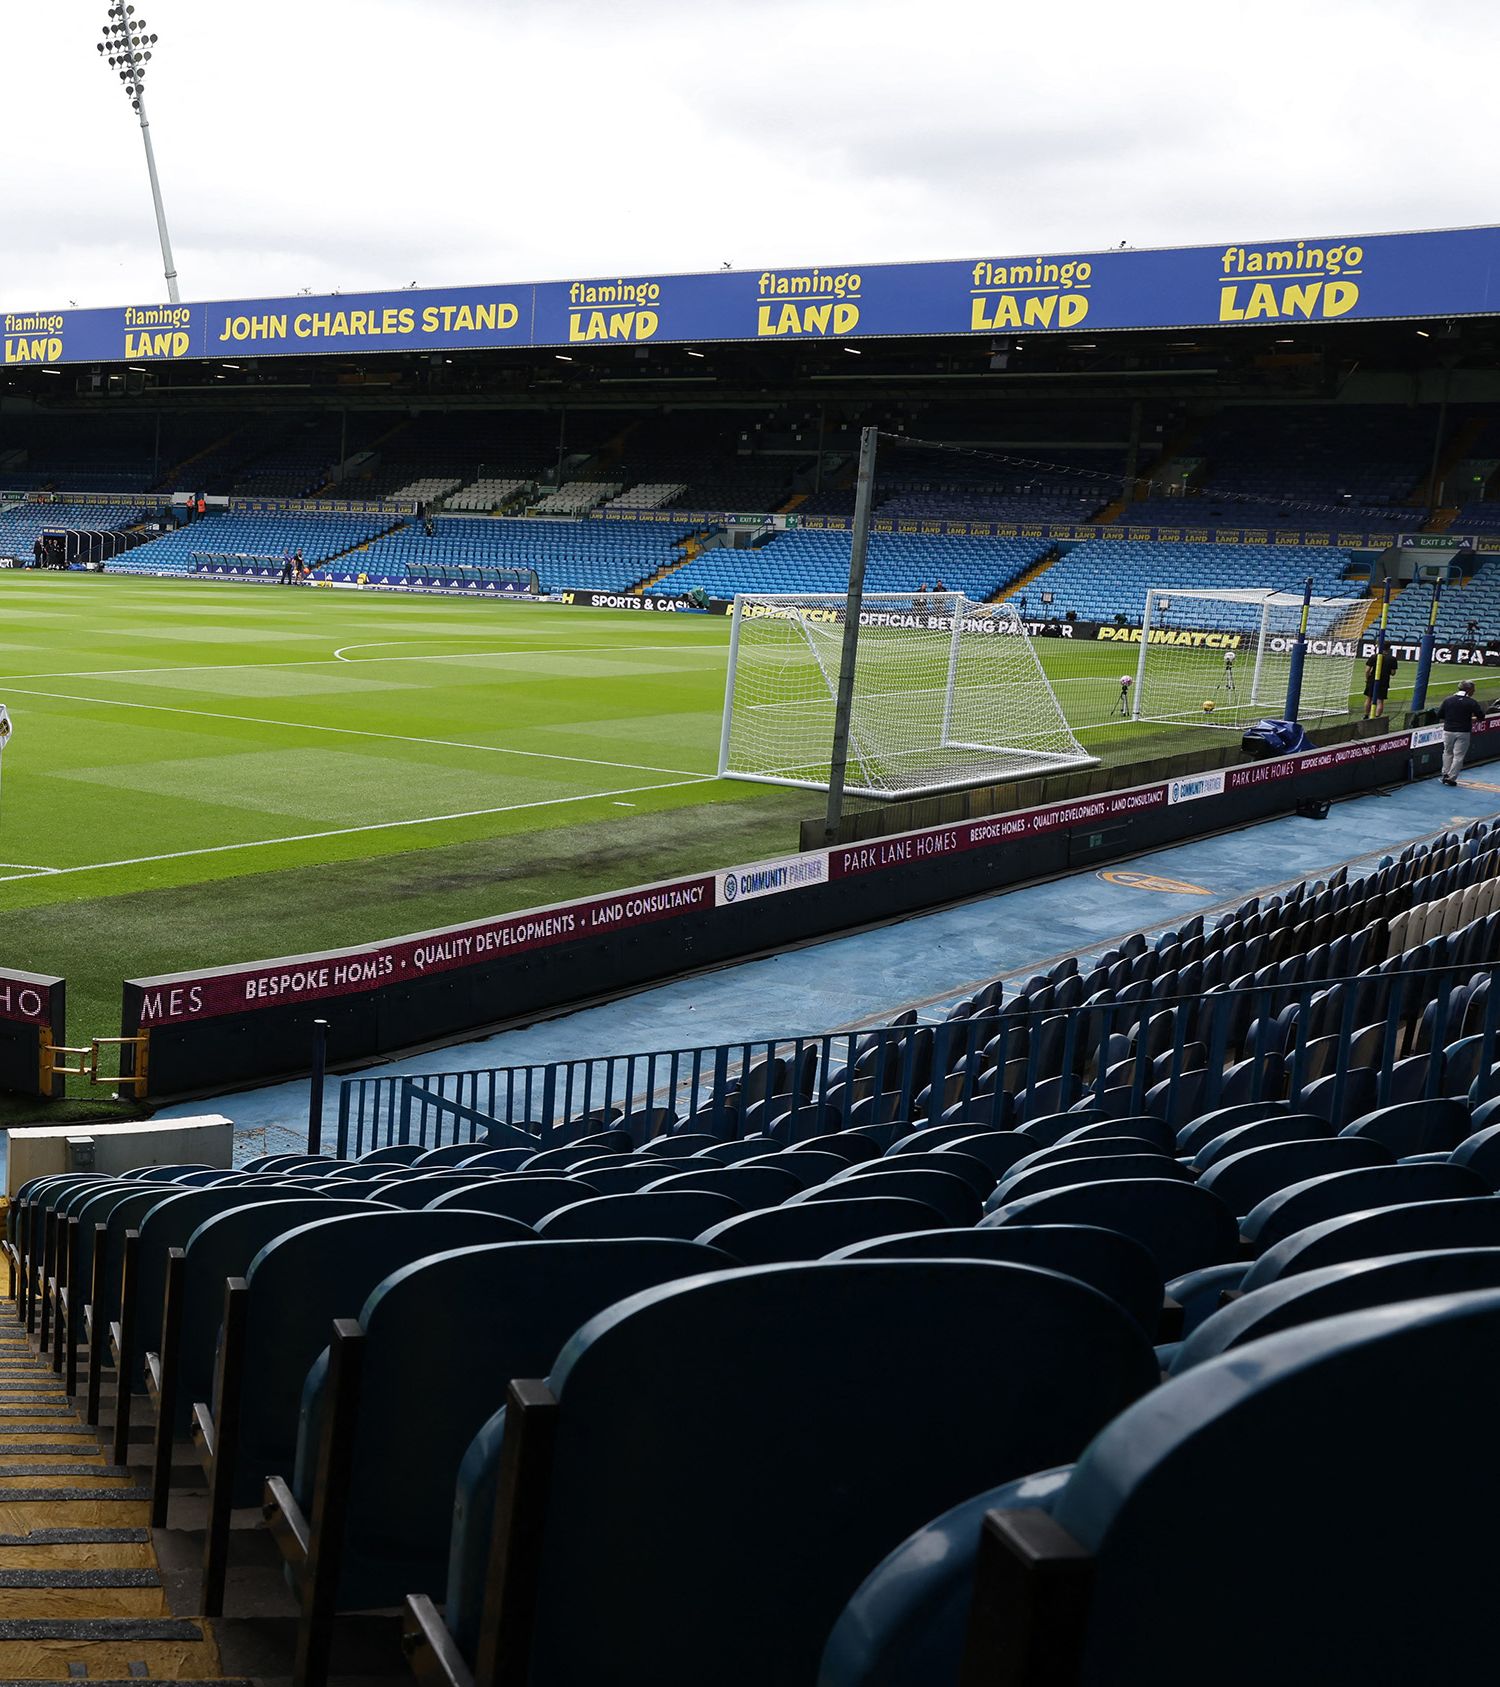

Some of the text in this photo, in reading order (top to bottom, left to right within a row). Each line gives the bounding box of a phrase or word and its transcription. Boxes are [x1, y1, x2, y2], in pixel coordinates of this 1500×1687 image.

[1221, 242, 1363, 275] flamingo
[758, 270, 861, 297] flamingo
[973, 258, 1092, 288] flamingo
[569, 280, 660, 305] flamingo
[1219, 281, 1359, 321] LAND
[5, 312, 63, 334] flamingo
[125, 305, 190, 327] flamingo
[219, 303, 519, 341] JOHN CHARLES STAND
[758, 303, 859, 335] LAND
[971, 294, 1089, 329] LAND
[569, 311, 658, 341] LAND
[5, 337, 63, 363] LAND
[125, 332, 190, 358] LAND
[1305, 538, 1330, 546] LAND
[1338, 539, 1362, 547] LAND
[1420, 538, 1439, 546] EXIT
[591, 594, 653, 611] SPORTS &
[725, 604, 837, 623] PARIMATCH
[859, 612, 922, 630] OFFICIAL
[1097, 626, 1240, 649] PARIMATCH
[1362, 642, 1451, 664] BTTIG
[1232, 772, 1250, 787] PARK
[1252, 767, 1269, 783] LANE
[1271, 762, 1294, 779] HOMES
[1301, 758, 1318, 770] BESPOKE
[1180, 782, 1204, 798] COMMUNITY
[844, 790, 1164, 873] PARK LANE HOMES BESPOKE HOMES QUALITY DEVELOPMENTS LAND CONSULTANCY
[741, 860, 822, 895] COMMUNITY PARTNER
[141, 885, 705, 1021] MES BESPOKE HOMES QUALITY DEVELOPMENTS LAND CONSULTANCY
